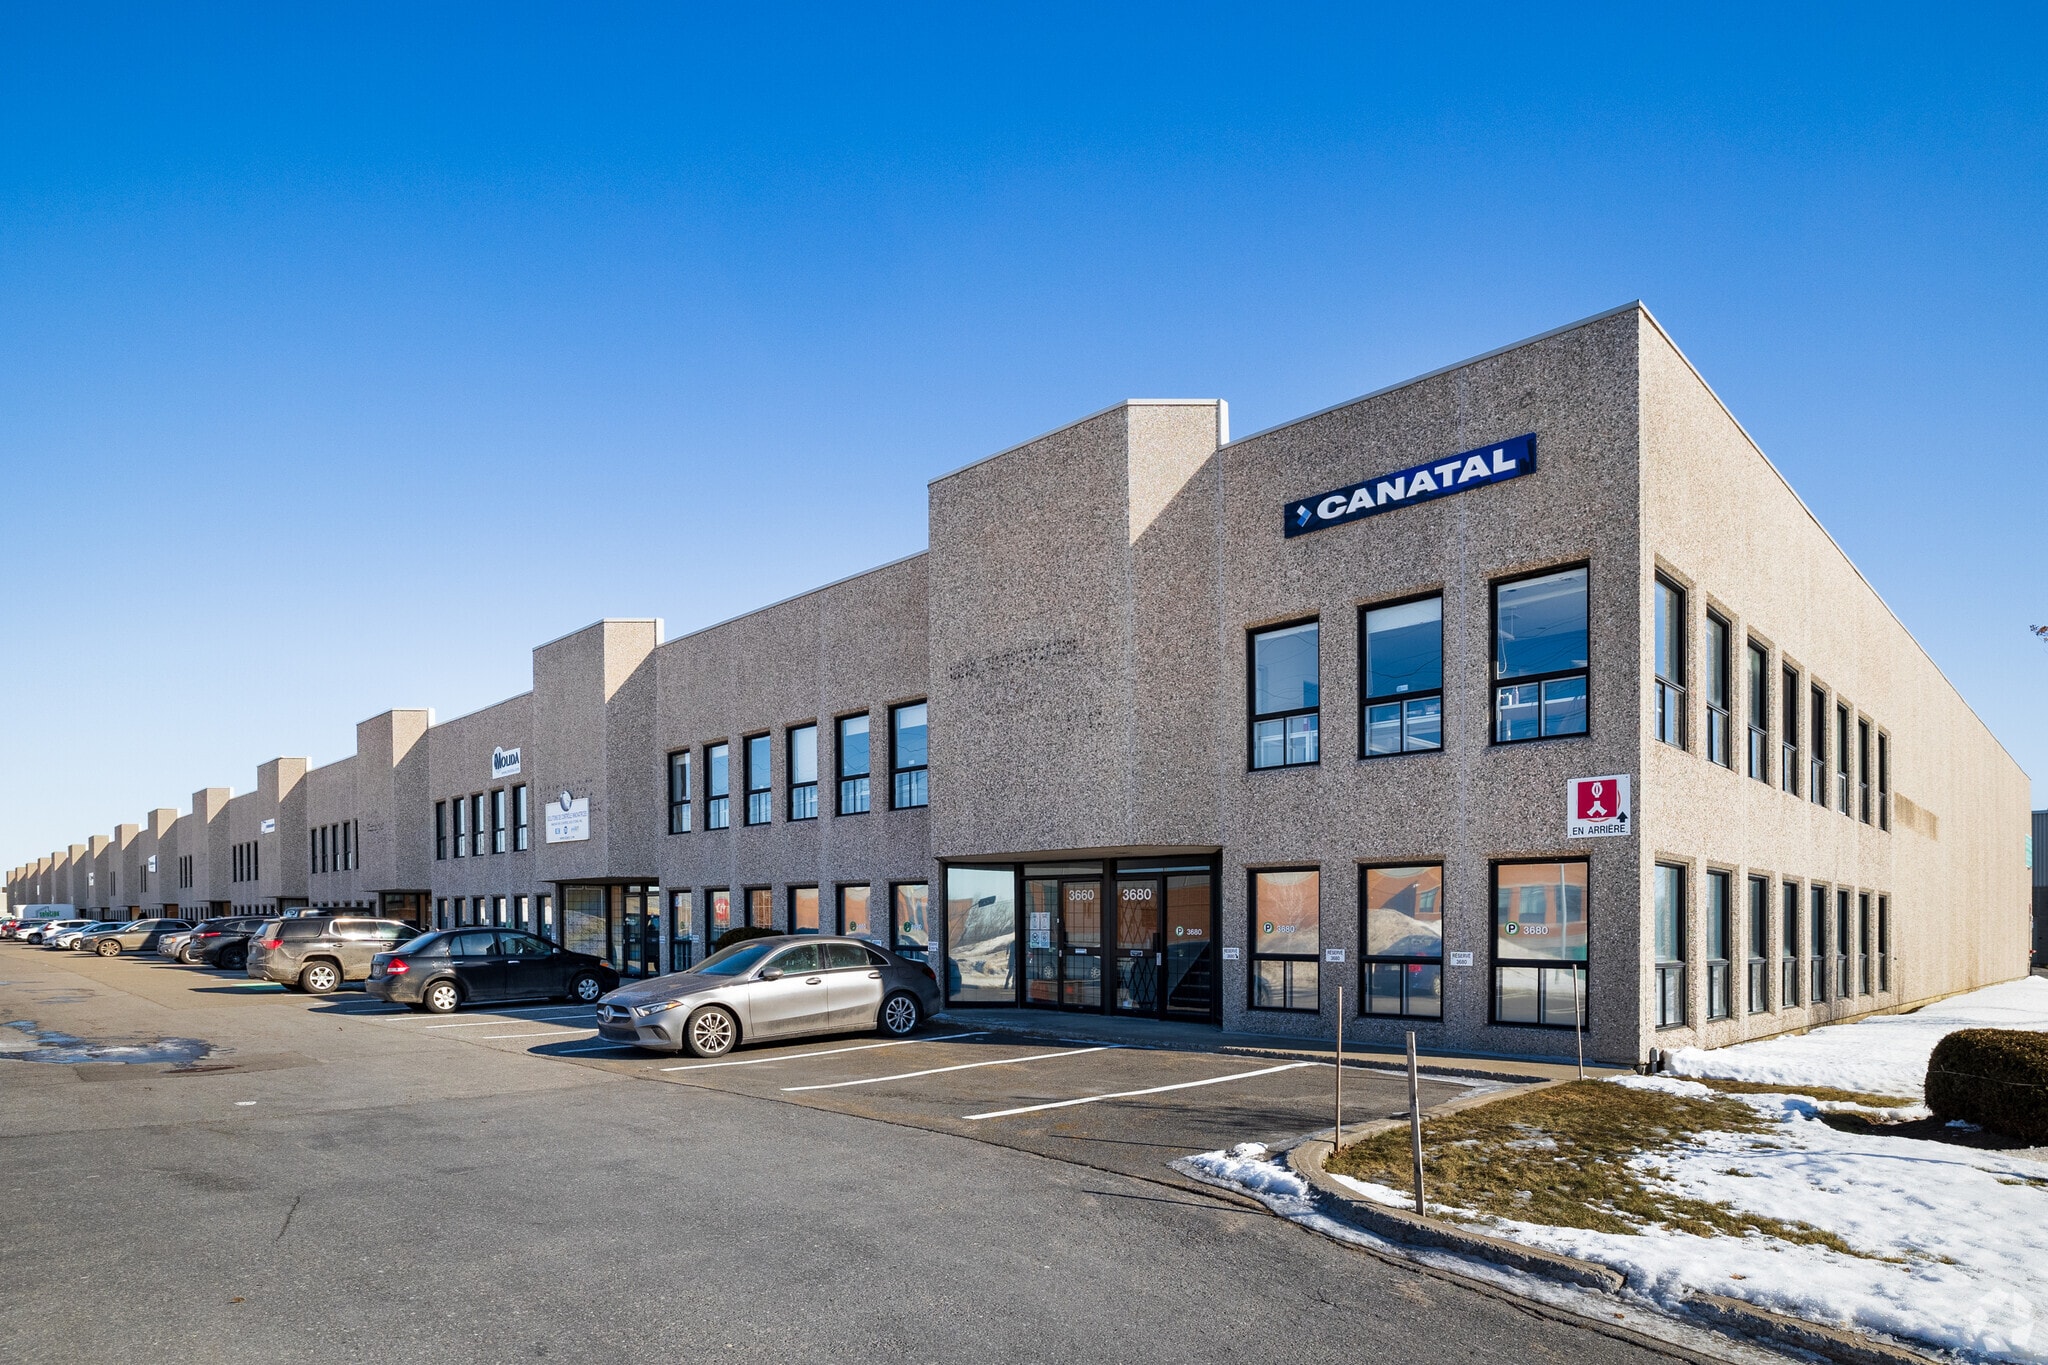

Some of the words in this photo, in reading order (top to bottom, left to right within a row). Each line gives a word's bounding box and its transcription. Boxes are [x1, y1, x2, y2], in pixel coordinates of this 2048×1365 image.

[1316, 449, 1516, 520] CANATAL
[1572, 827, 1584, 836] EN
[1069, 889, 1095, 901] 3660
[1122, 888, 1152, 901] 3680
[1186, 928, 1202, 936] 3680
[1276, 925, 1296, 933] 3680
[1523, 926, 1549, 935] 3680
